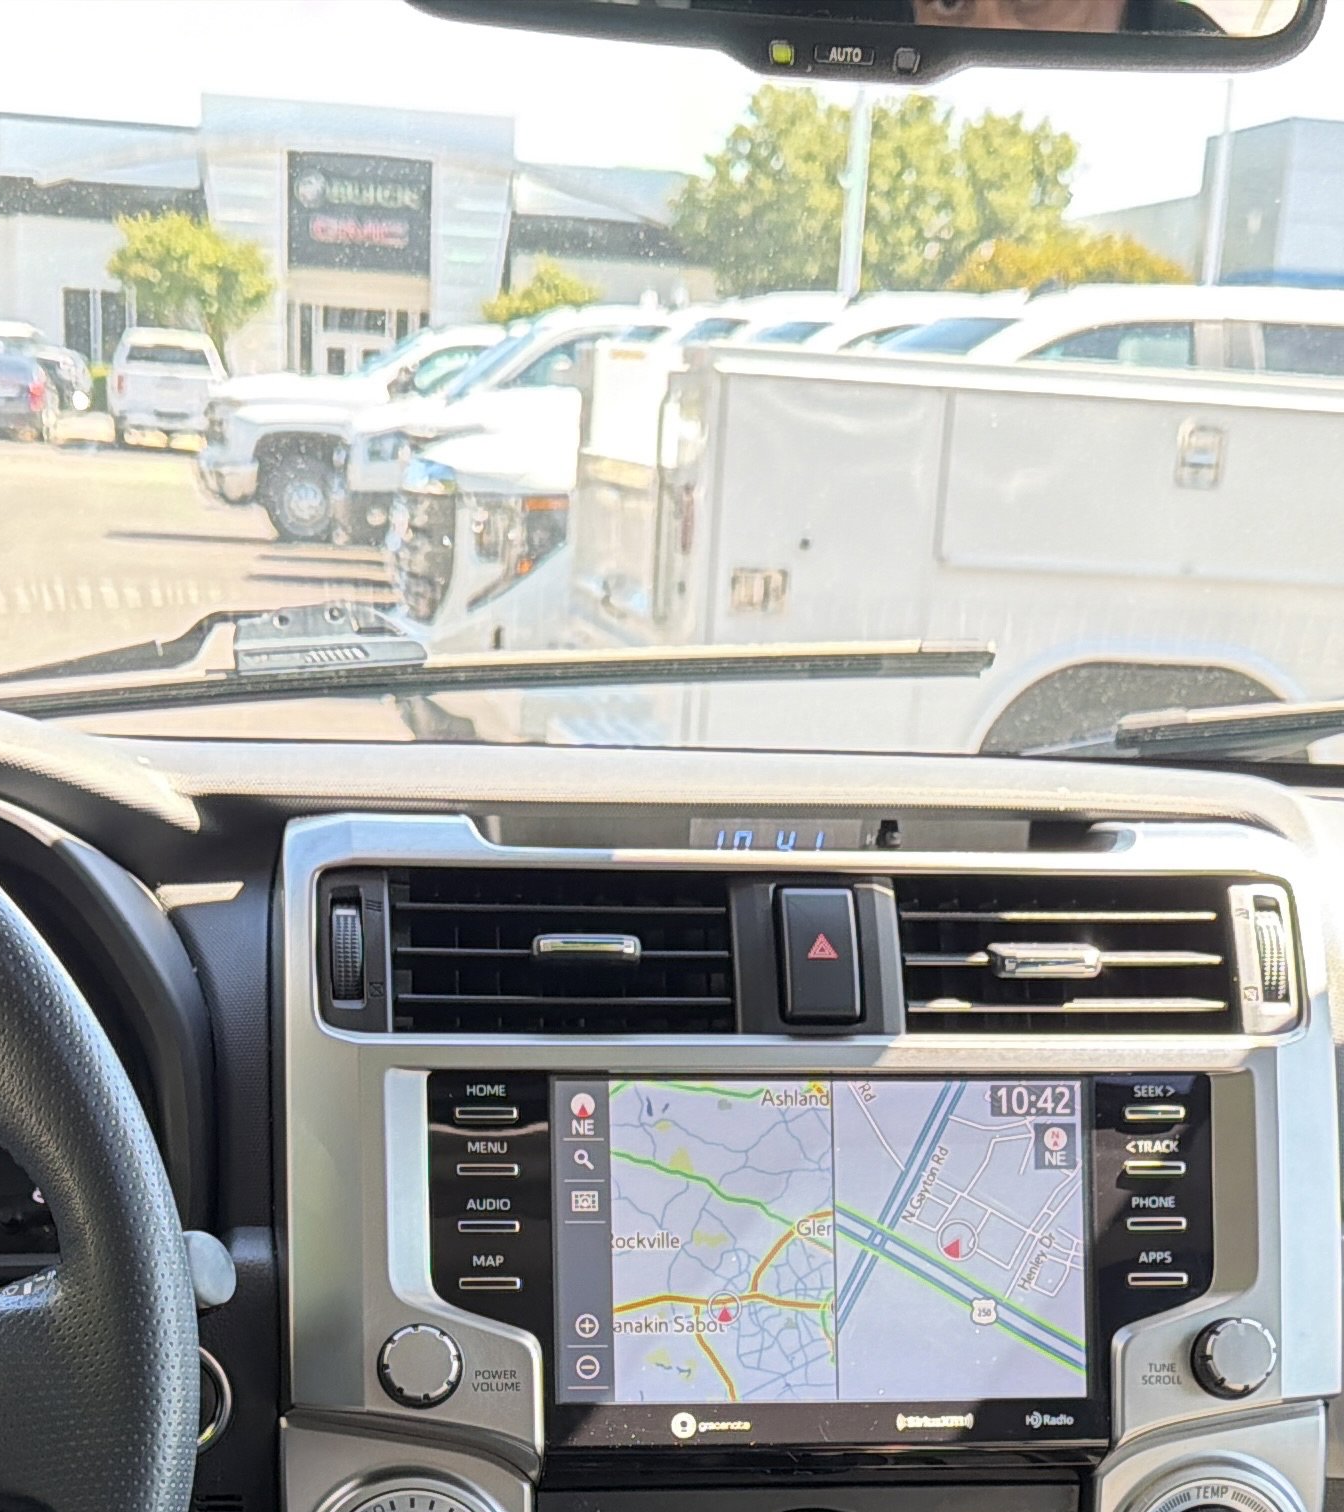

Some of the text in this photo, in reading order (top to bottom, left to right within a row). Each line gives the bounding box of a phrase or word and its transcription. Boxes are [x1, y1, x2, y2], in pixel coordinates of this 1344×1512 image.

[828, 46, 862, 62] AUTO
[466, 1085, 506, 1097] HOME
[859, 1083, 877, 1103] Rd
[761, 1088, 830, 1107] Ashland
[996, 1087, 1072, 1115] 10:42
[572, 1120, 595, 1135] NE
[467, 1142, 508, 1154] MENU
[1044, 1151, 1067, 1166] NE
[909, 1166, 940, 1211] Gayton
[931, 1145, 950, 1169] Rd
[466, 1199, 511, 1211] AUDIO
[1131, 1196, 1176, 1208] PHONE
[472, 1255, 505, 1267] MAP
[1017, 1231, 1057, 1291] Henley Dr
[1138, 1252, 1173, 1265] APPS
[474, 1369, 517, 1380] POWER
[1148, 1363, 1176, 1374] TUNE
[471, 1381, 521, 1393] VOLUME
[1141, 1375, 1182, 1387] SCROLL
[1043, 1415, 1074, 1426] Radio
[1195, 1486, 1229, 1500] TEMP
